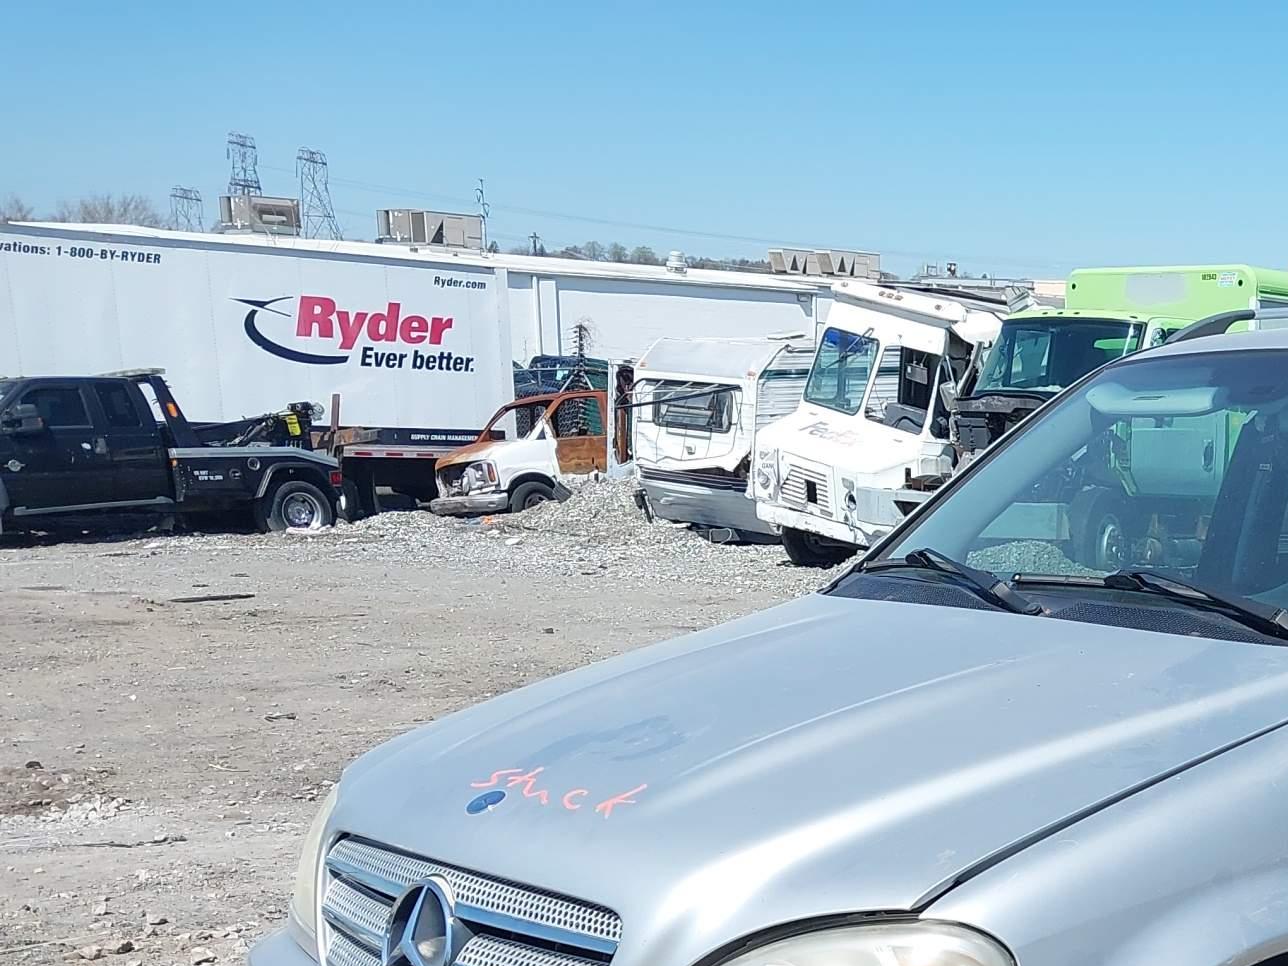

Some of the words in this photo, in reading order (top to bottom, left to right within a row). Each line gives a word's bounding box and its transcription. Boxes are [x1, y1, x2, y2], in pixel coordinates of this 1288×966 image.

[56, 246, 161, 264] 1-800-BY-RYDER
[433, 276, 487, 290] Ryder.com
[296, 296, 453, 350] Ryder
[360, 347, 408, 369] Ever
[412, 350, 475, 372] better.
[447, 435, 480, 443] MANAGEMEN
